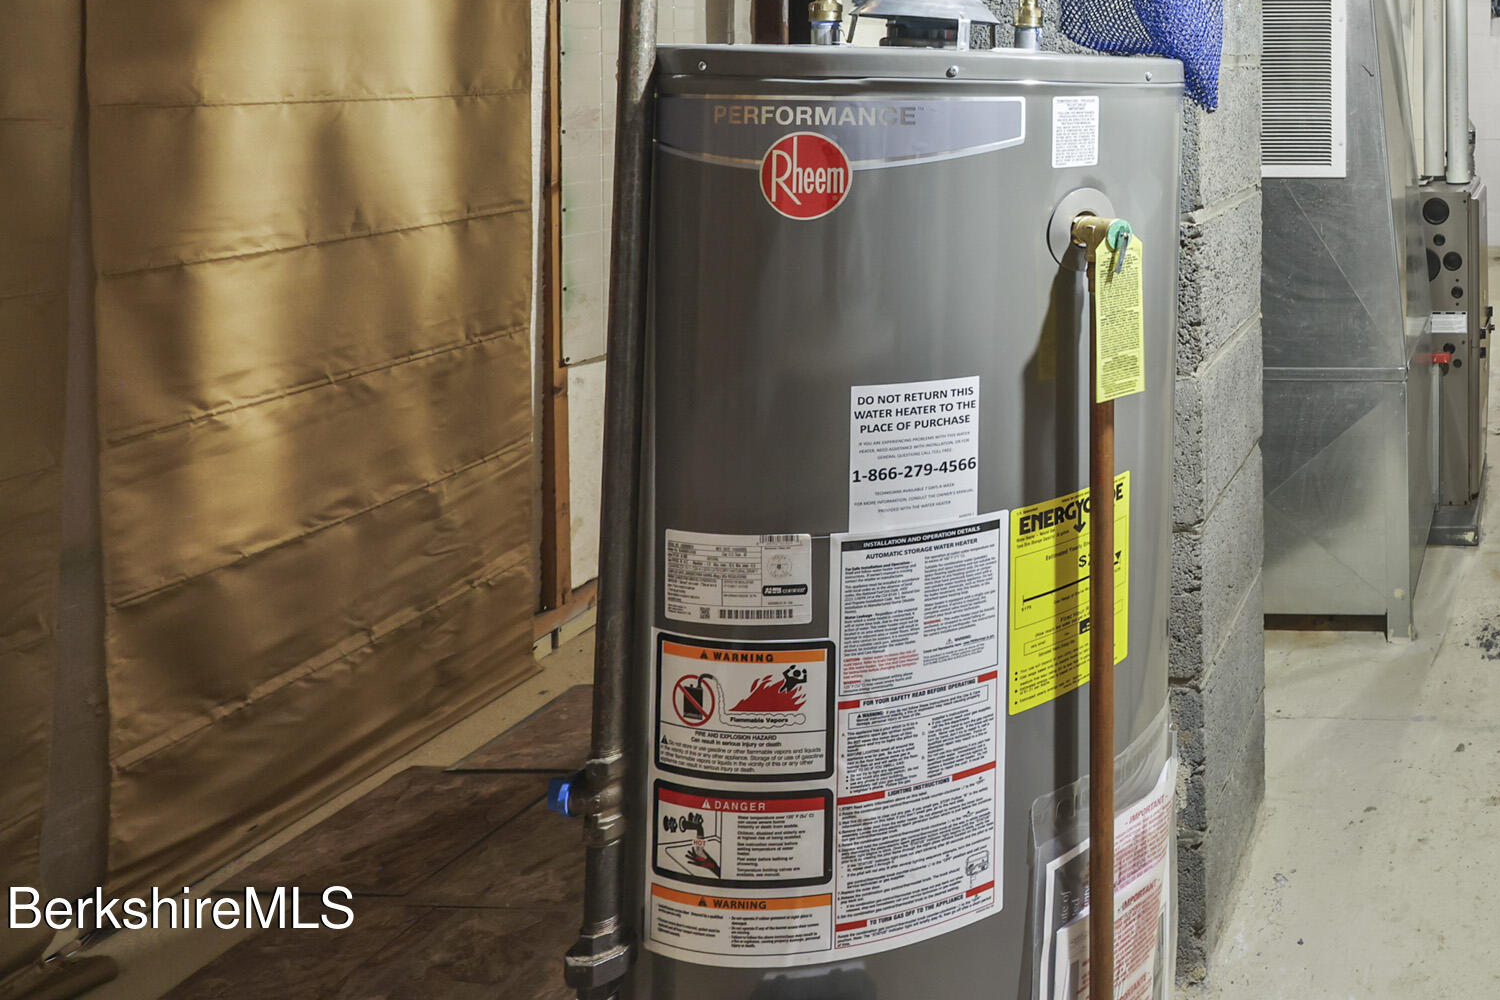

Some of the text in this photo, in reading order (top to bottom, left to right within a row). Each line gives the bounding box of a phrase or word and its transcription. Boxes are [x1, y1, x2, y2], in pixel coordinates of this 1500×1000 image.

[713, 105, 917, 126] PERFORMANCE
[771, 136, 844, 206] Rheem
[857, 386, 974, 406] DO NOT RETURN THIS
[854, 399, 976, 420] WATER HEATER TO THE
[860, 414, 971, 434] PLACE OF PURCHASE
[852, 457, 977, 483] 1-866-279-4566
[863, 525, 981, 548] INSTALLATION AND OPERATION DETAILS
[866, 537, 978, 560] AUTOMATIC STORAGE WATER HEATER
[713, 651, 774, 662] WARNING
[875, 697, 890, 705] YOUR
[890, 693, 911, 703] SAFETY
[926, 687, 947, 695] BEFORE
[947, 679, 976, 690] OPERATING
[887, 777, 950, 797] LIGHTING INSTRUCTIONS
[714, 800, 766, 811] DANGER
[1129, 794, 1166, 824] IMPORTANT
[713, 899, 767, 910] WARNING
[1121, 880, 1157, 910] IMPORTANT
[870, 894, 964, 926] TO TURN GAS OFF TO THE APPLIANCE
